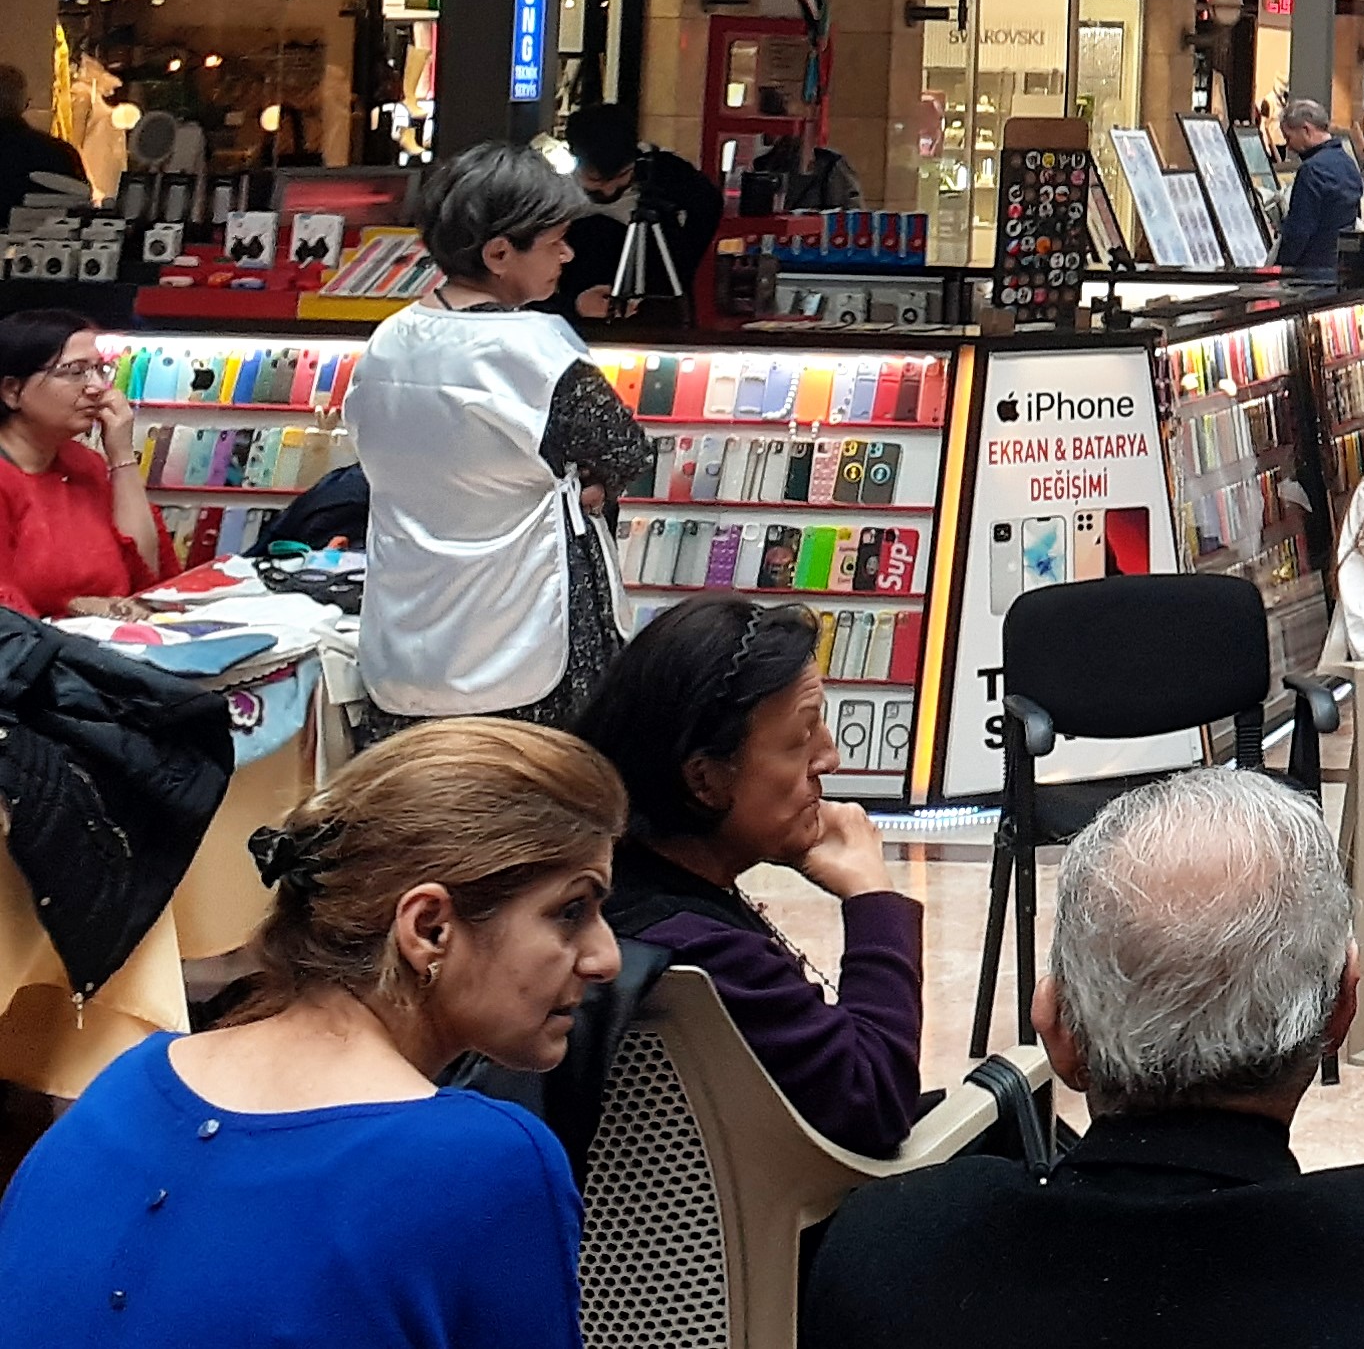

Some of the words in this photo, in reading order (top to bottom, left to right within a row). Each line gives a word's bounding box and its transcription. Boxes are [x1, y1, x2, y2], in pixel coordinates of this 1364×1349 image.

[1027, 391, 1135, 423] iPhone
[988, 438, 1049, 466] EKRAN
[1055, 437, 1067, 462] &
[1072, 433, 1149, 461] BATARYA
[1030, 467, 1109, 506] DEĞİŞİMİ
